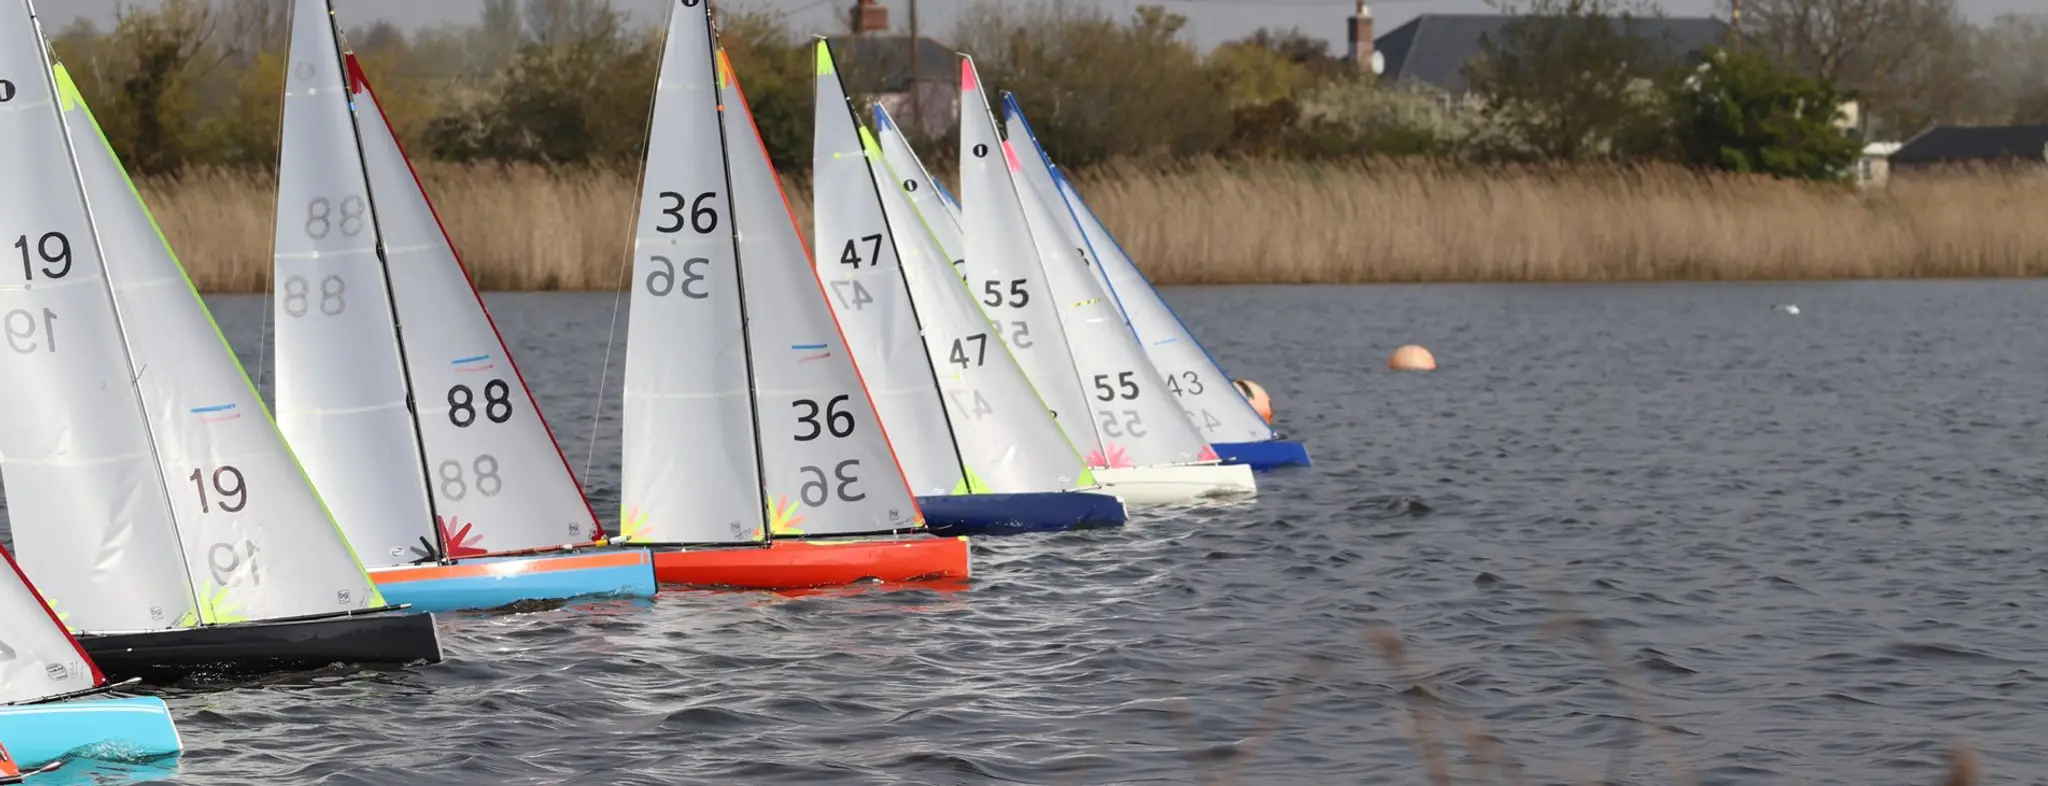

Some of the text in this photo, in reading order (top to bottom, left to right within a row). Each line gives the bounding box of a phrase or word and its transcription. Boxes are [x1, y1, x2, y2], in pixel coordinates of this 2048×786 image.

[305, 196, 364, 239] 88
[656, 191, 717, 234] 36
[14, 231, 72, 280] 19
[840, 234, 882, 269] 47
[984, 279, 1029, 308] 55
[949, 333, 987, 369] 47
[447, 379, 512, 427] 88
[1094, 371, 1139, 401] 55
[1167, 371, 1204, 397] 43
[792, 394, 855, 441] 36
[189, 465, 247, 513] 19
